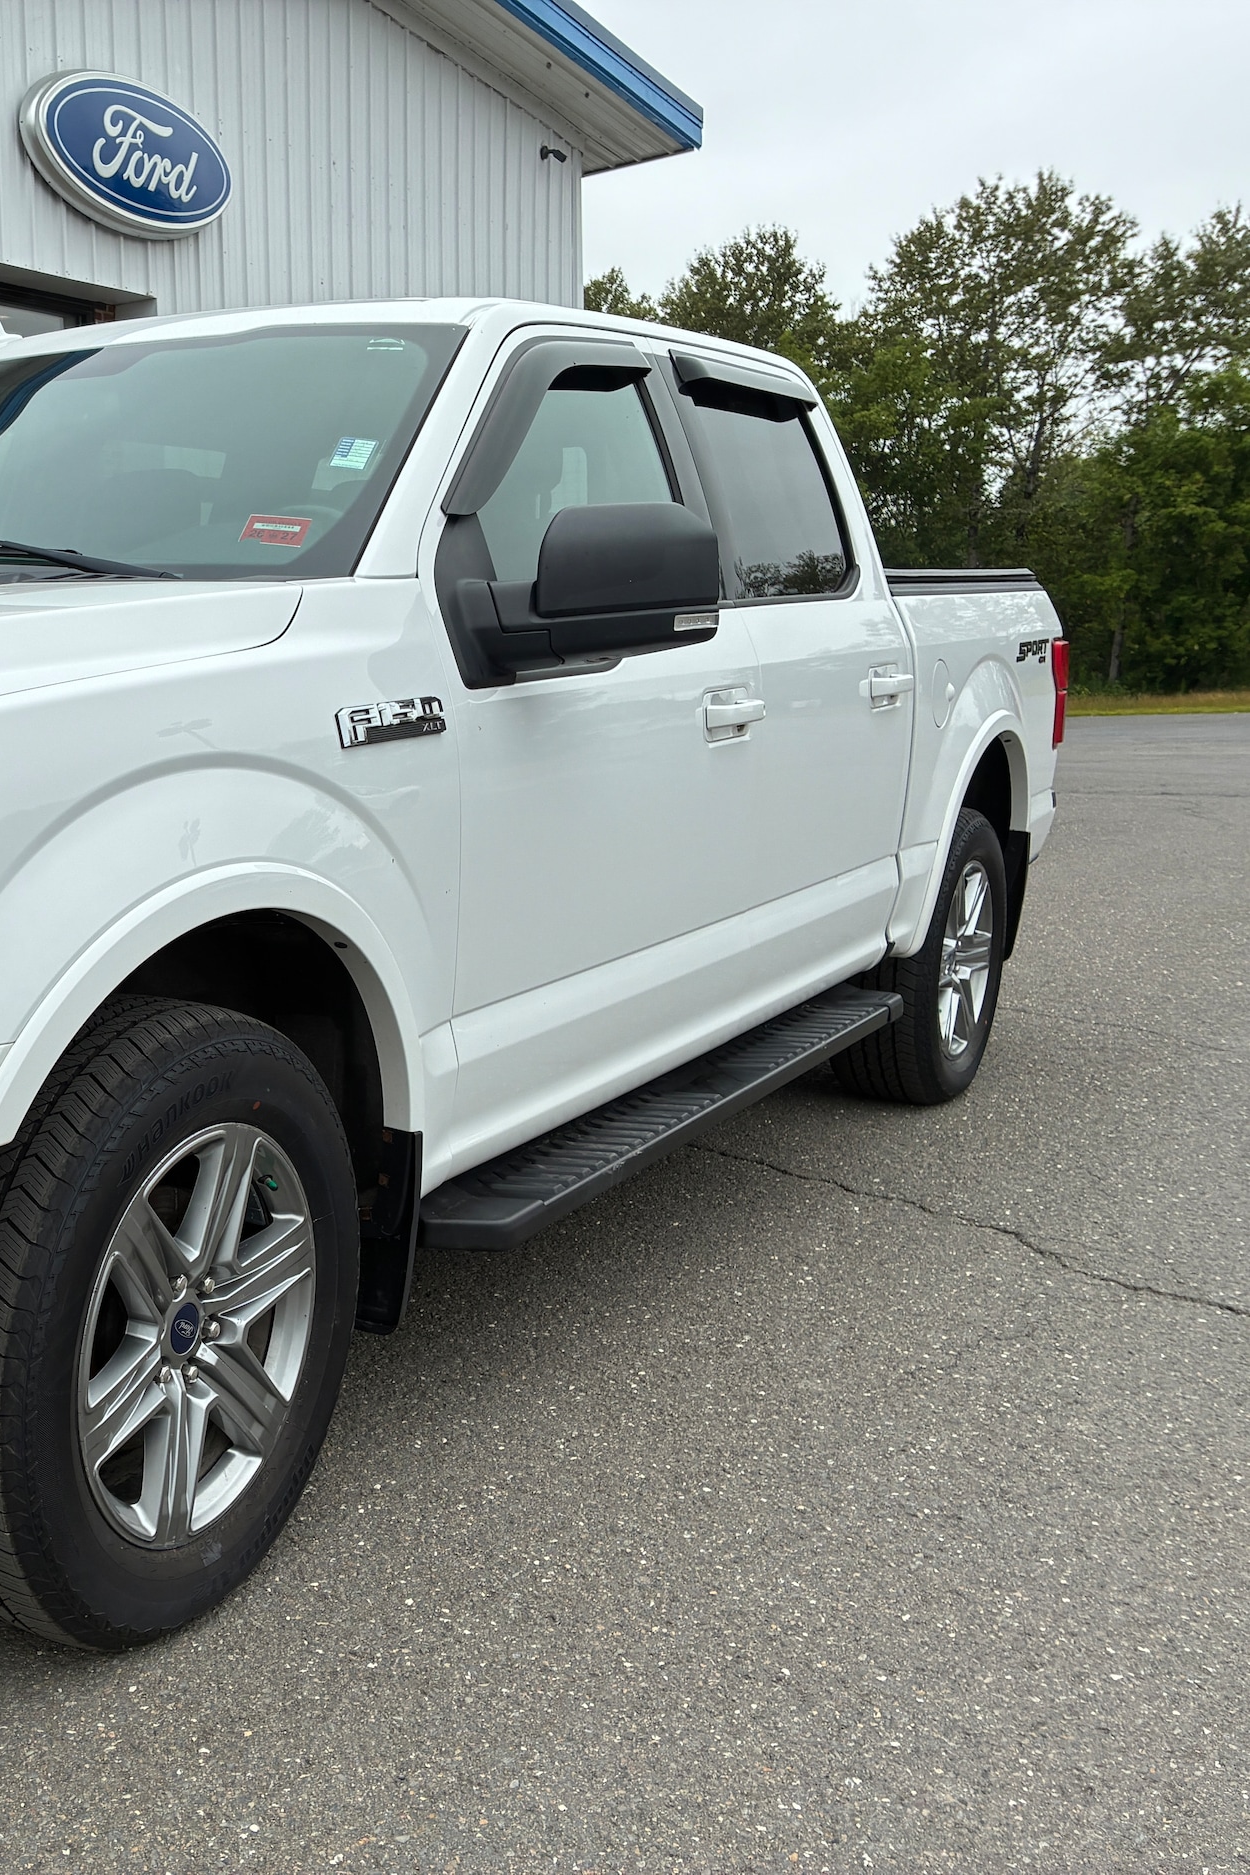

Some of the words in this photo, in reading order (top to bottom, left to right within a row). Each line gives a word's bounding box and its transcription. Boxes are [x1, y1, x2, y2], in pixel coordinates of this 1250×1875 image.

[92, 104, 198, 203] Ford
[1015, 638, 1050, 663] SPORT
[422, 721, 443, 733] XLT
